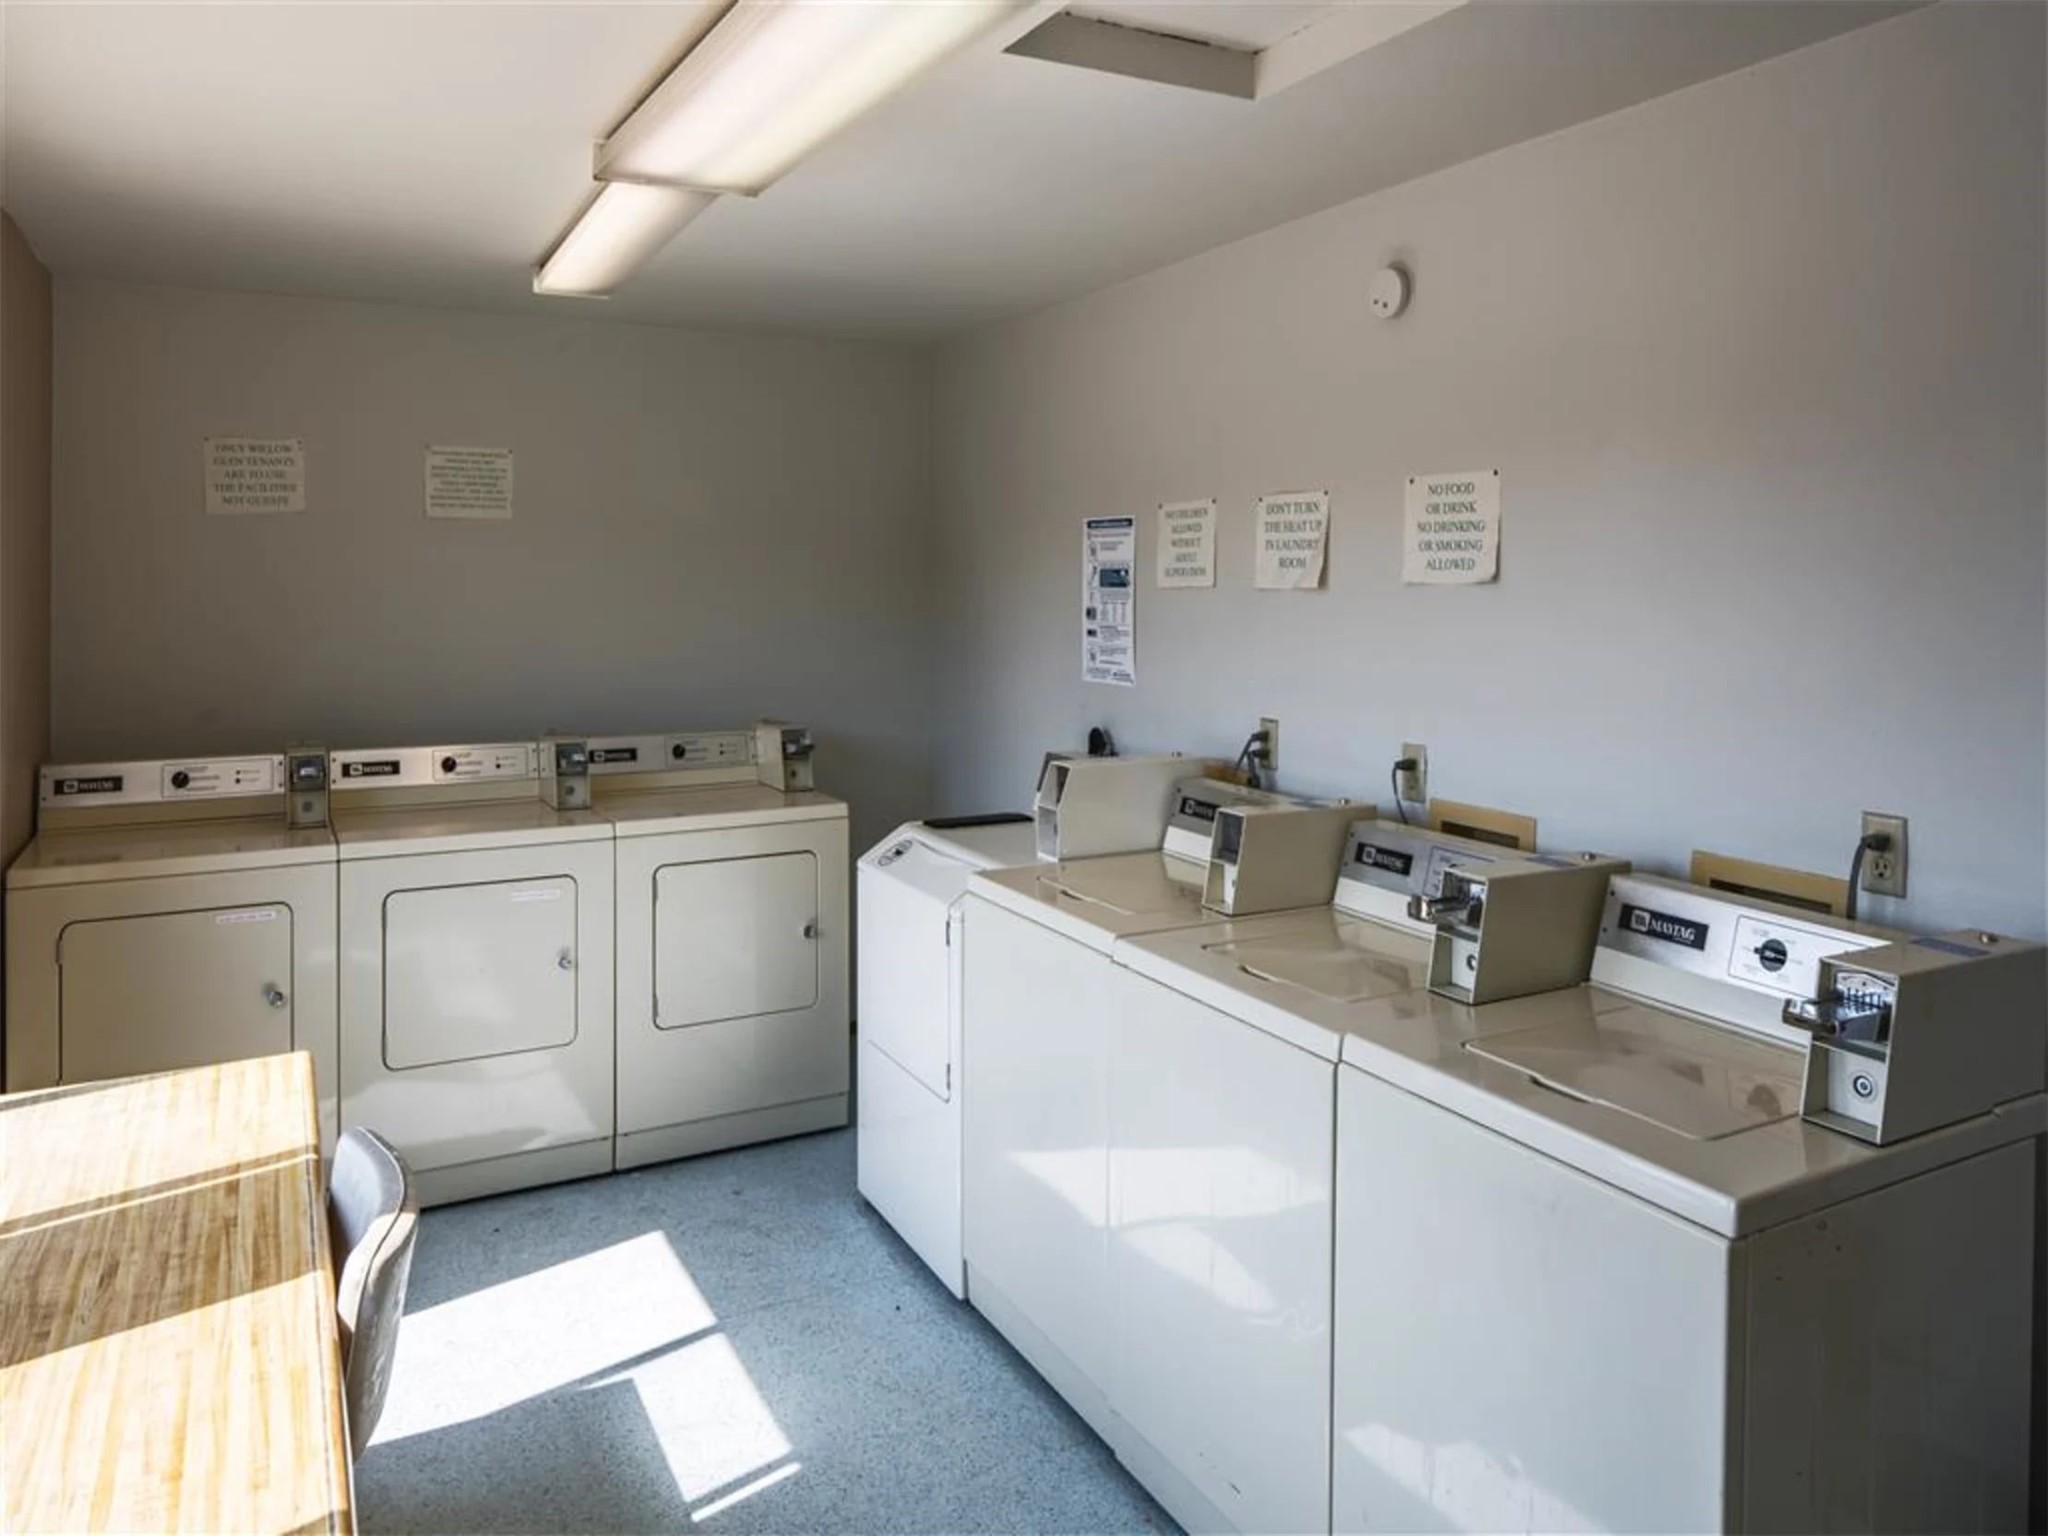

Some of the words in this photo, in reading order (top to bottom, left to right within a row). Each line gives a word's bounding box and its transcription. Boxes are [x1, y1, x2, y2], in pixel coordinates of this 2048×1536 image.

[214, 483, 236, 492] THE
[1427, 483, 1443, 496] NO
[1445, 481, 1475, 496] FOOD
[1266, 503, 1291, 515] DON'T
[1293, 501, 1319, 513] TURN
[1425, 502, 1440, 514] OR
[1442, 500, 1477, 514] DRINK
[1265, 521, 1281, 533] THE
[1282, 520, 1307, 532] HEAT
[1308, 519, 1322, 532] UP
[1417, 521, 1433, 533] NO
[1433, 520, 1486, 533] DRINKING
[1265, 540, 1274, 550] IN
[1275, 539, 1320, 550] LAUNDRY
[1418, 541, 1434, 552] OR
[1435, 540, 1483, 552] SMOKING
[1279, 557, 1307, 568] ROOM
[1426, 558, 1475, 571] ALLOWED
[1650, 917, 1697, 942] MAYTAG
